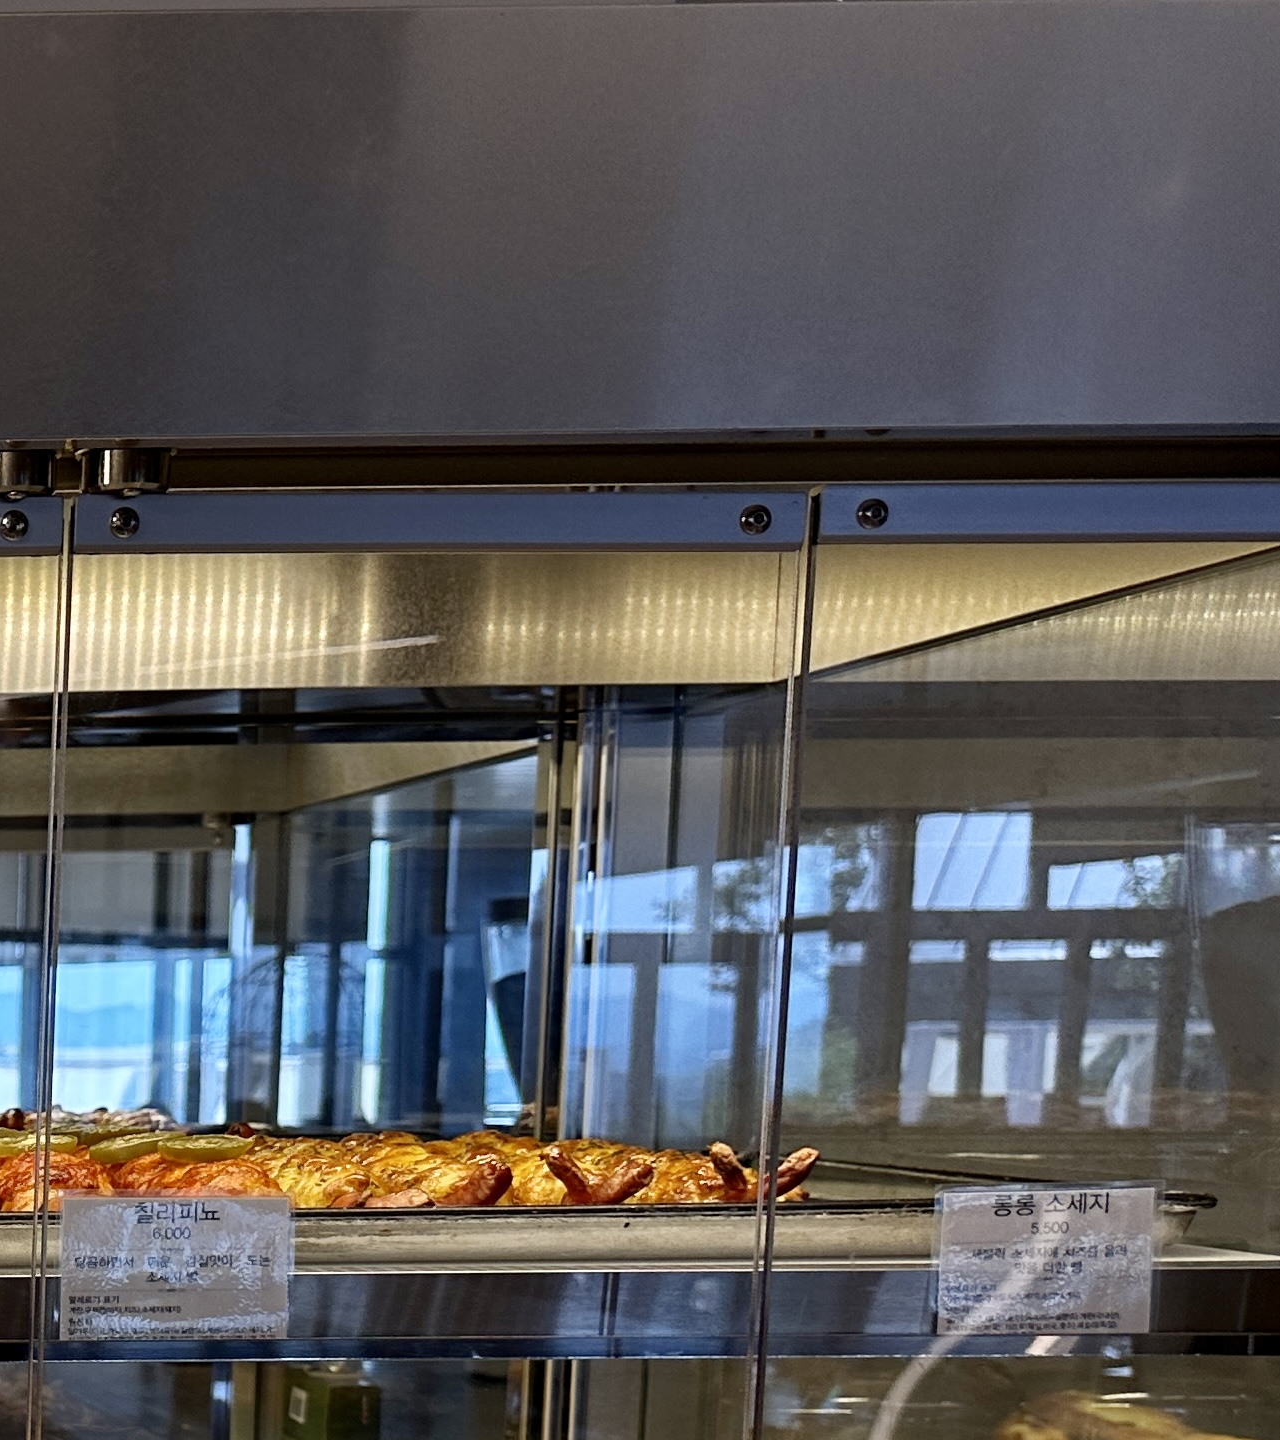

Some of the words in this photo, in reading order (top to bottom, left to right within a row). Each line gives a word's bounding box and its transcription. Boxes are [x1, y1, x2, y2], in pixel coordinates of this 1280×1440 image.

[992, 1193, 1036, 1217] 롱롱
[1044, 1191, 1110, 1214] 소세지
[152, 1226, 192, 1240] 6,000
